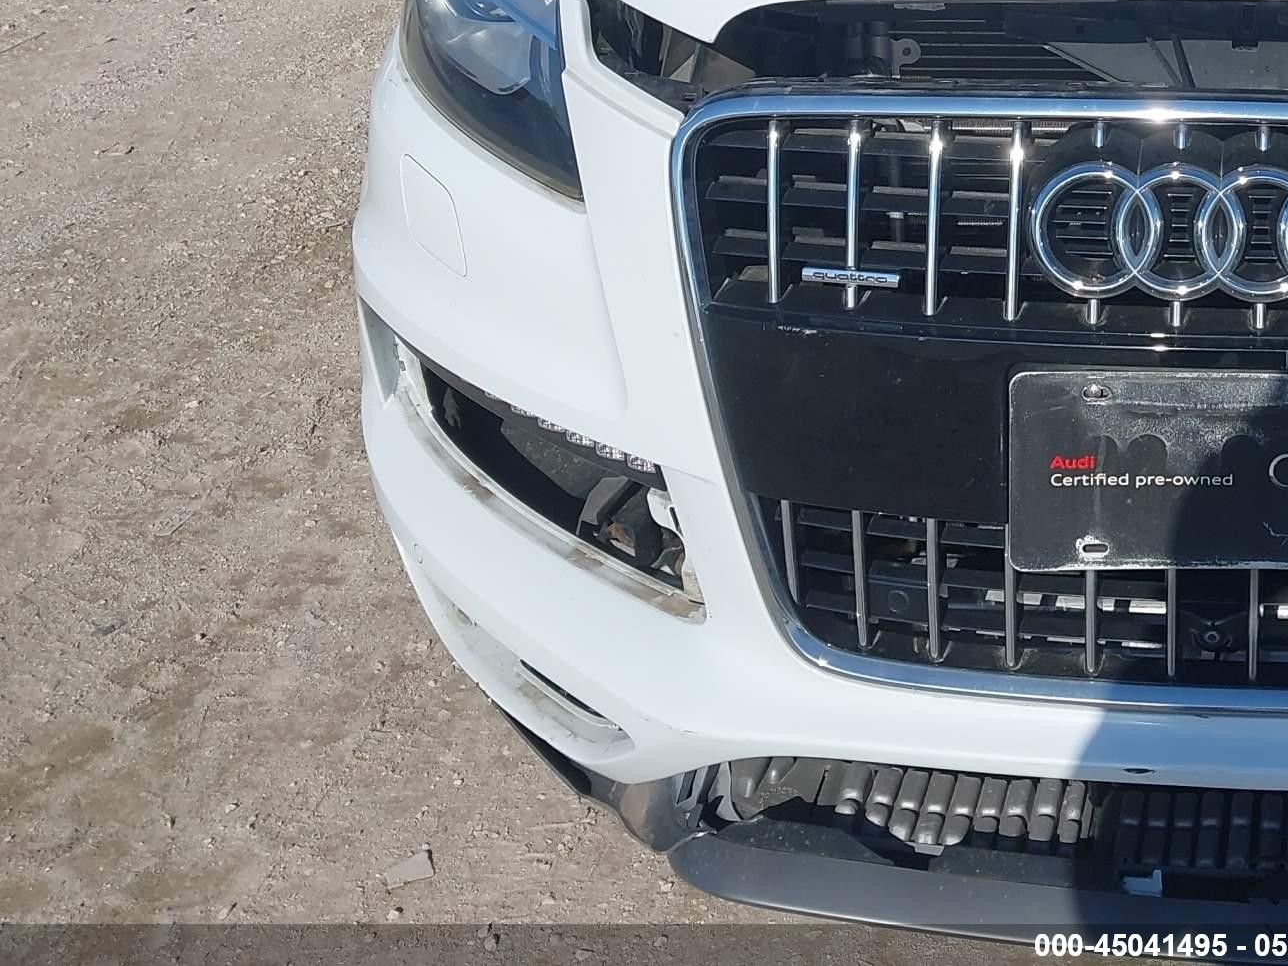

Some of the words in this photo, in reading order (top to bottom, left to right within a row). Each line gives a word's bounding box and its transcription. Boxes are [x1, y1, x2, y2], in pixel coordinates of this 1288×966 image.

[812, 271, 888, 283] quattro
[1050, 455, 1095, 470] Audi
[1050, 472, 1129, 487] Certified
[1135, 472, 1234, 489] pre-owned
